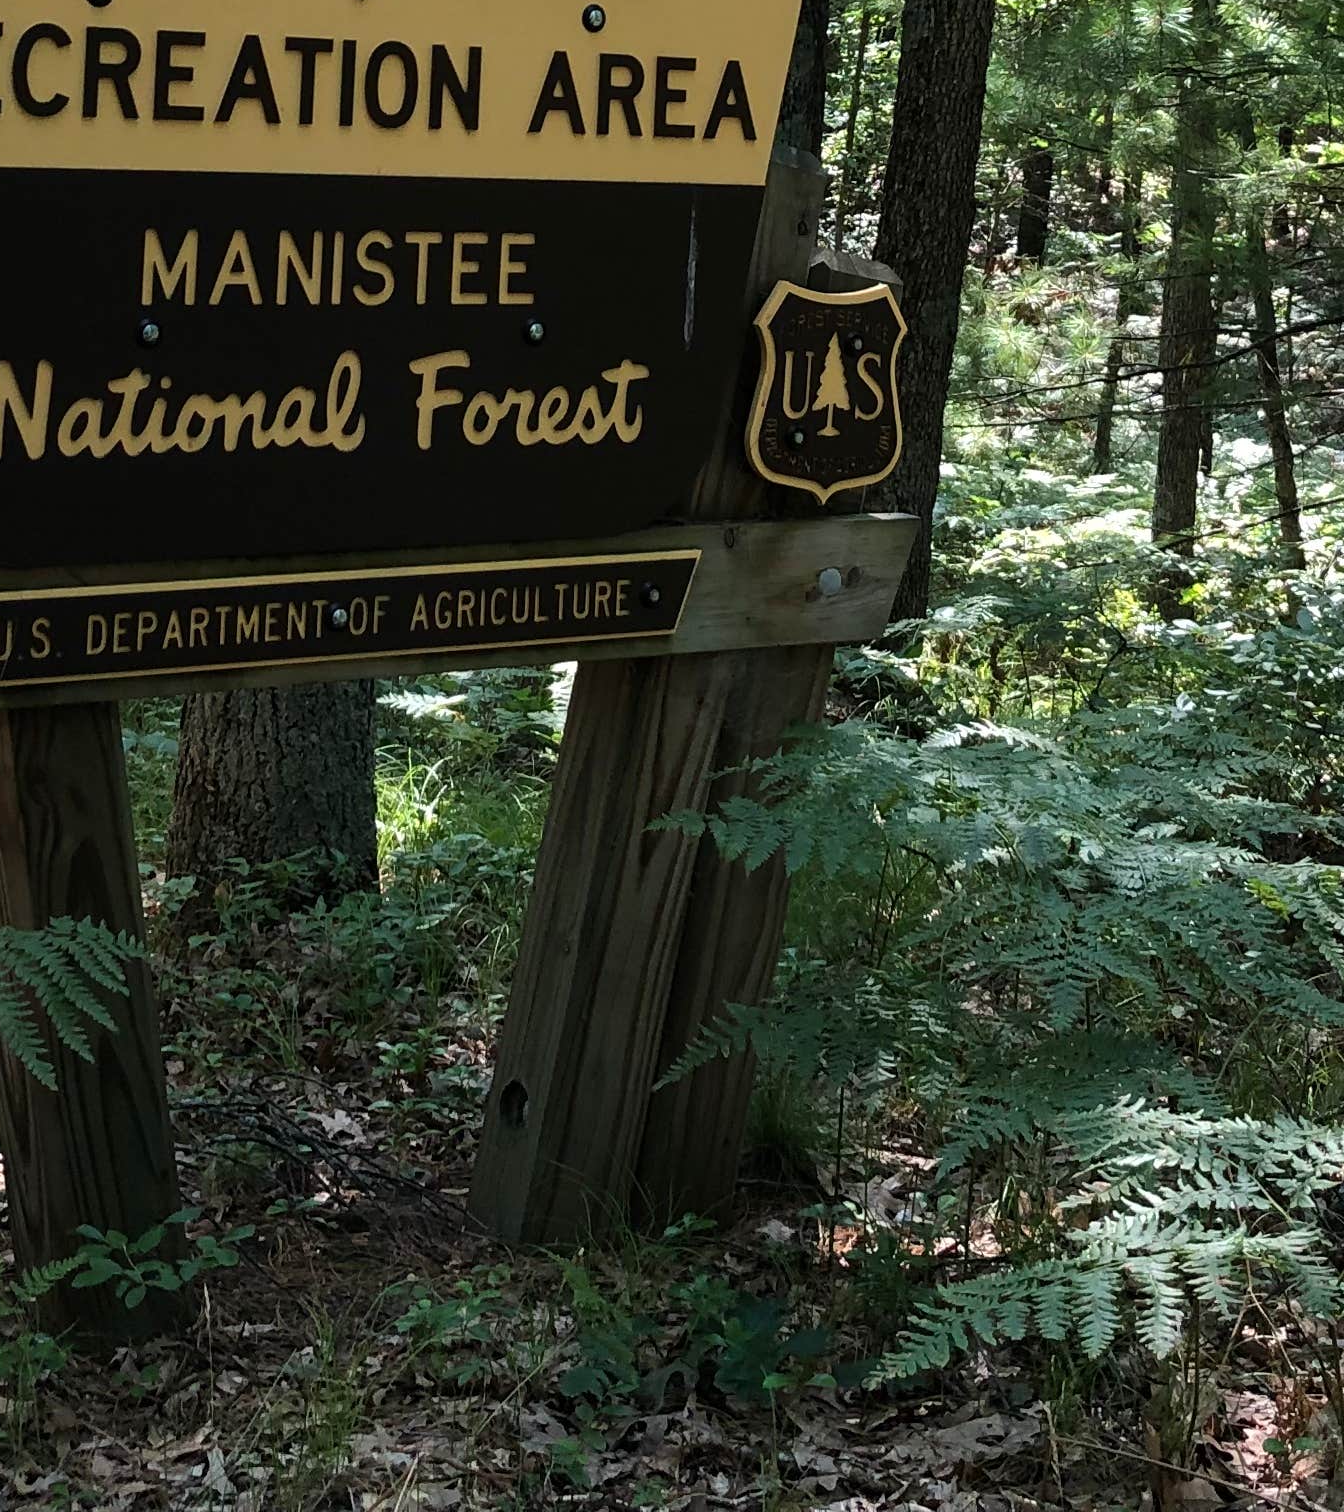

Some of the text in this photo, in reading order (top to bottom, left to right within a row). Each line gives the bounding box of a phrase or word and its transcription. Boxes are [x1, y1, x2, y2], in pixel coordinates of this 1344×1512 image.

[527, 50, 758, 141] AREA
[141, 229, 536, 306] MANISTEE
[408, 350, 650, 450] Forest
[85, 598, 329, 656] DEPARTMENT
[348, 595, 391, 636] OF
[409, 579, 633, 632] AGRICULTURE
